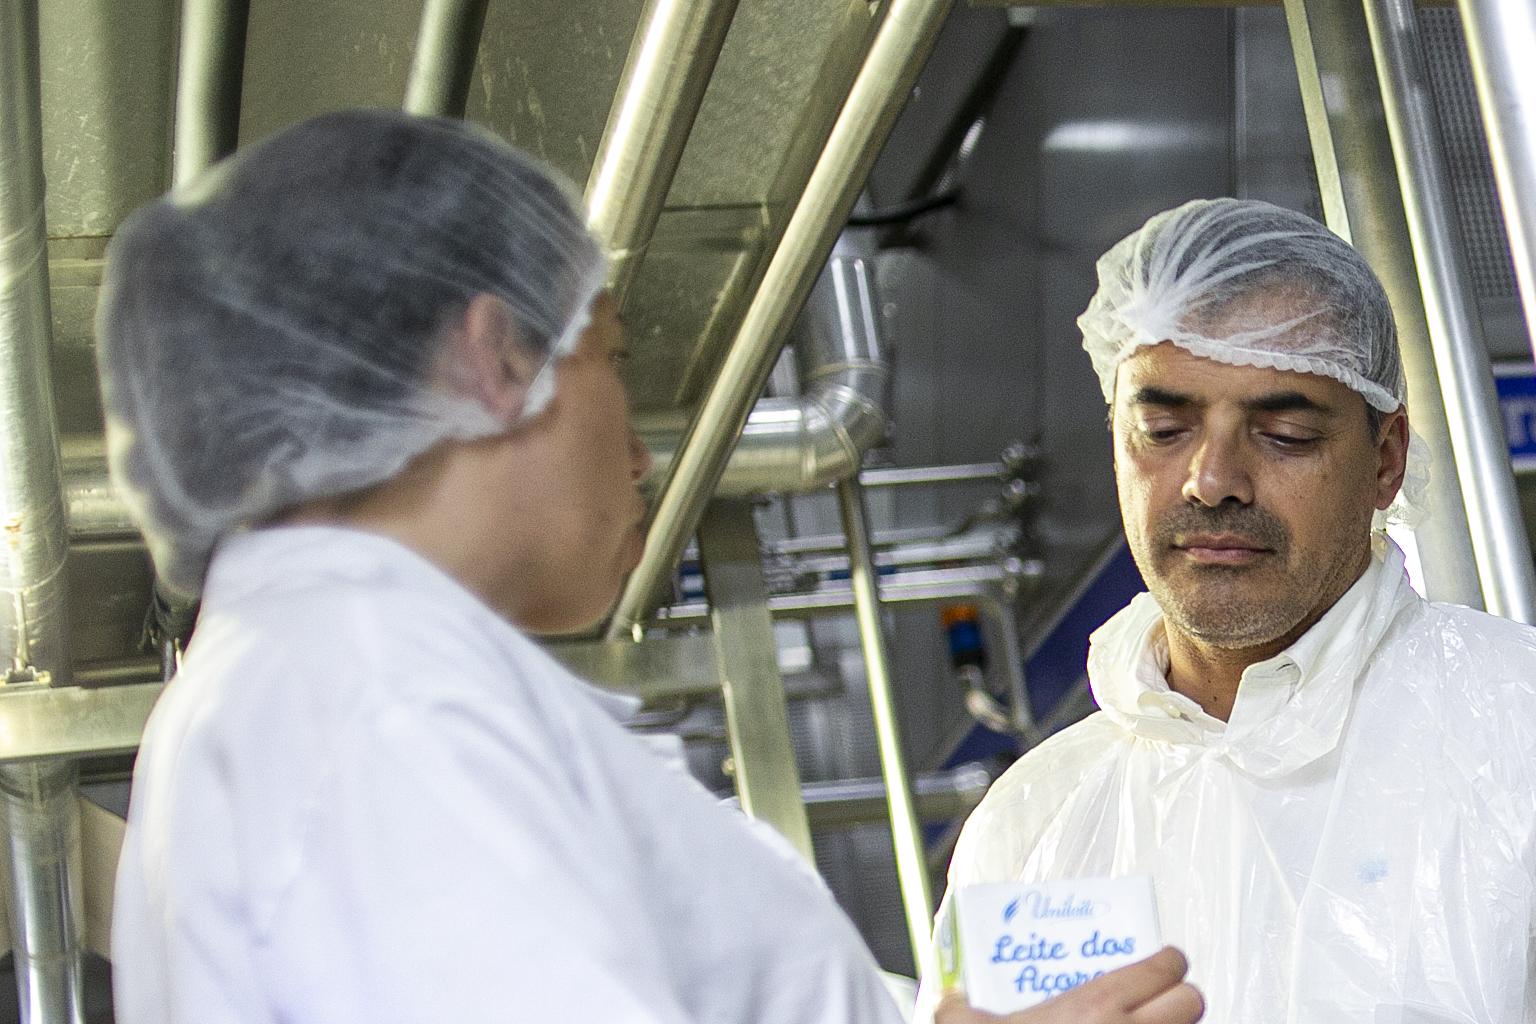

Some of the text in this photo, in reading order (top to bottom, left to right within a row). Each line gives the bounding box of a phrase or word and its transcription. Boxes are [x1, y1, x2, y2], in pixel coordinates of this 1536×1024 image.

[991, 930, 1135, 963] Leite dos
[1014, 965, 1104, 1000] Açor
